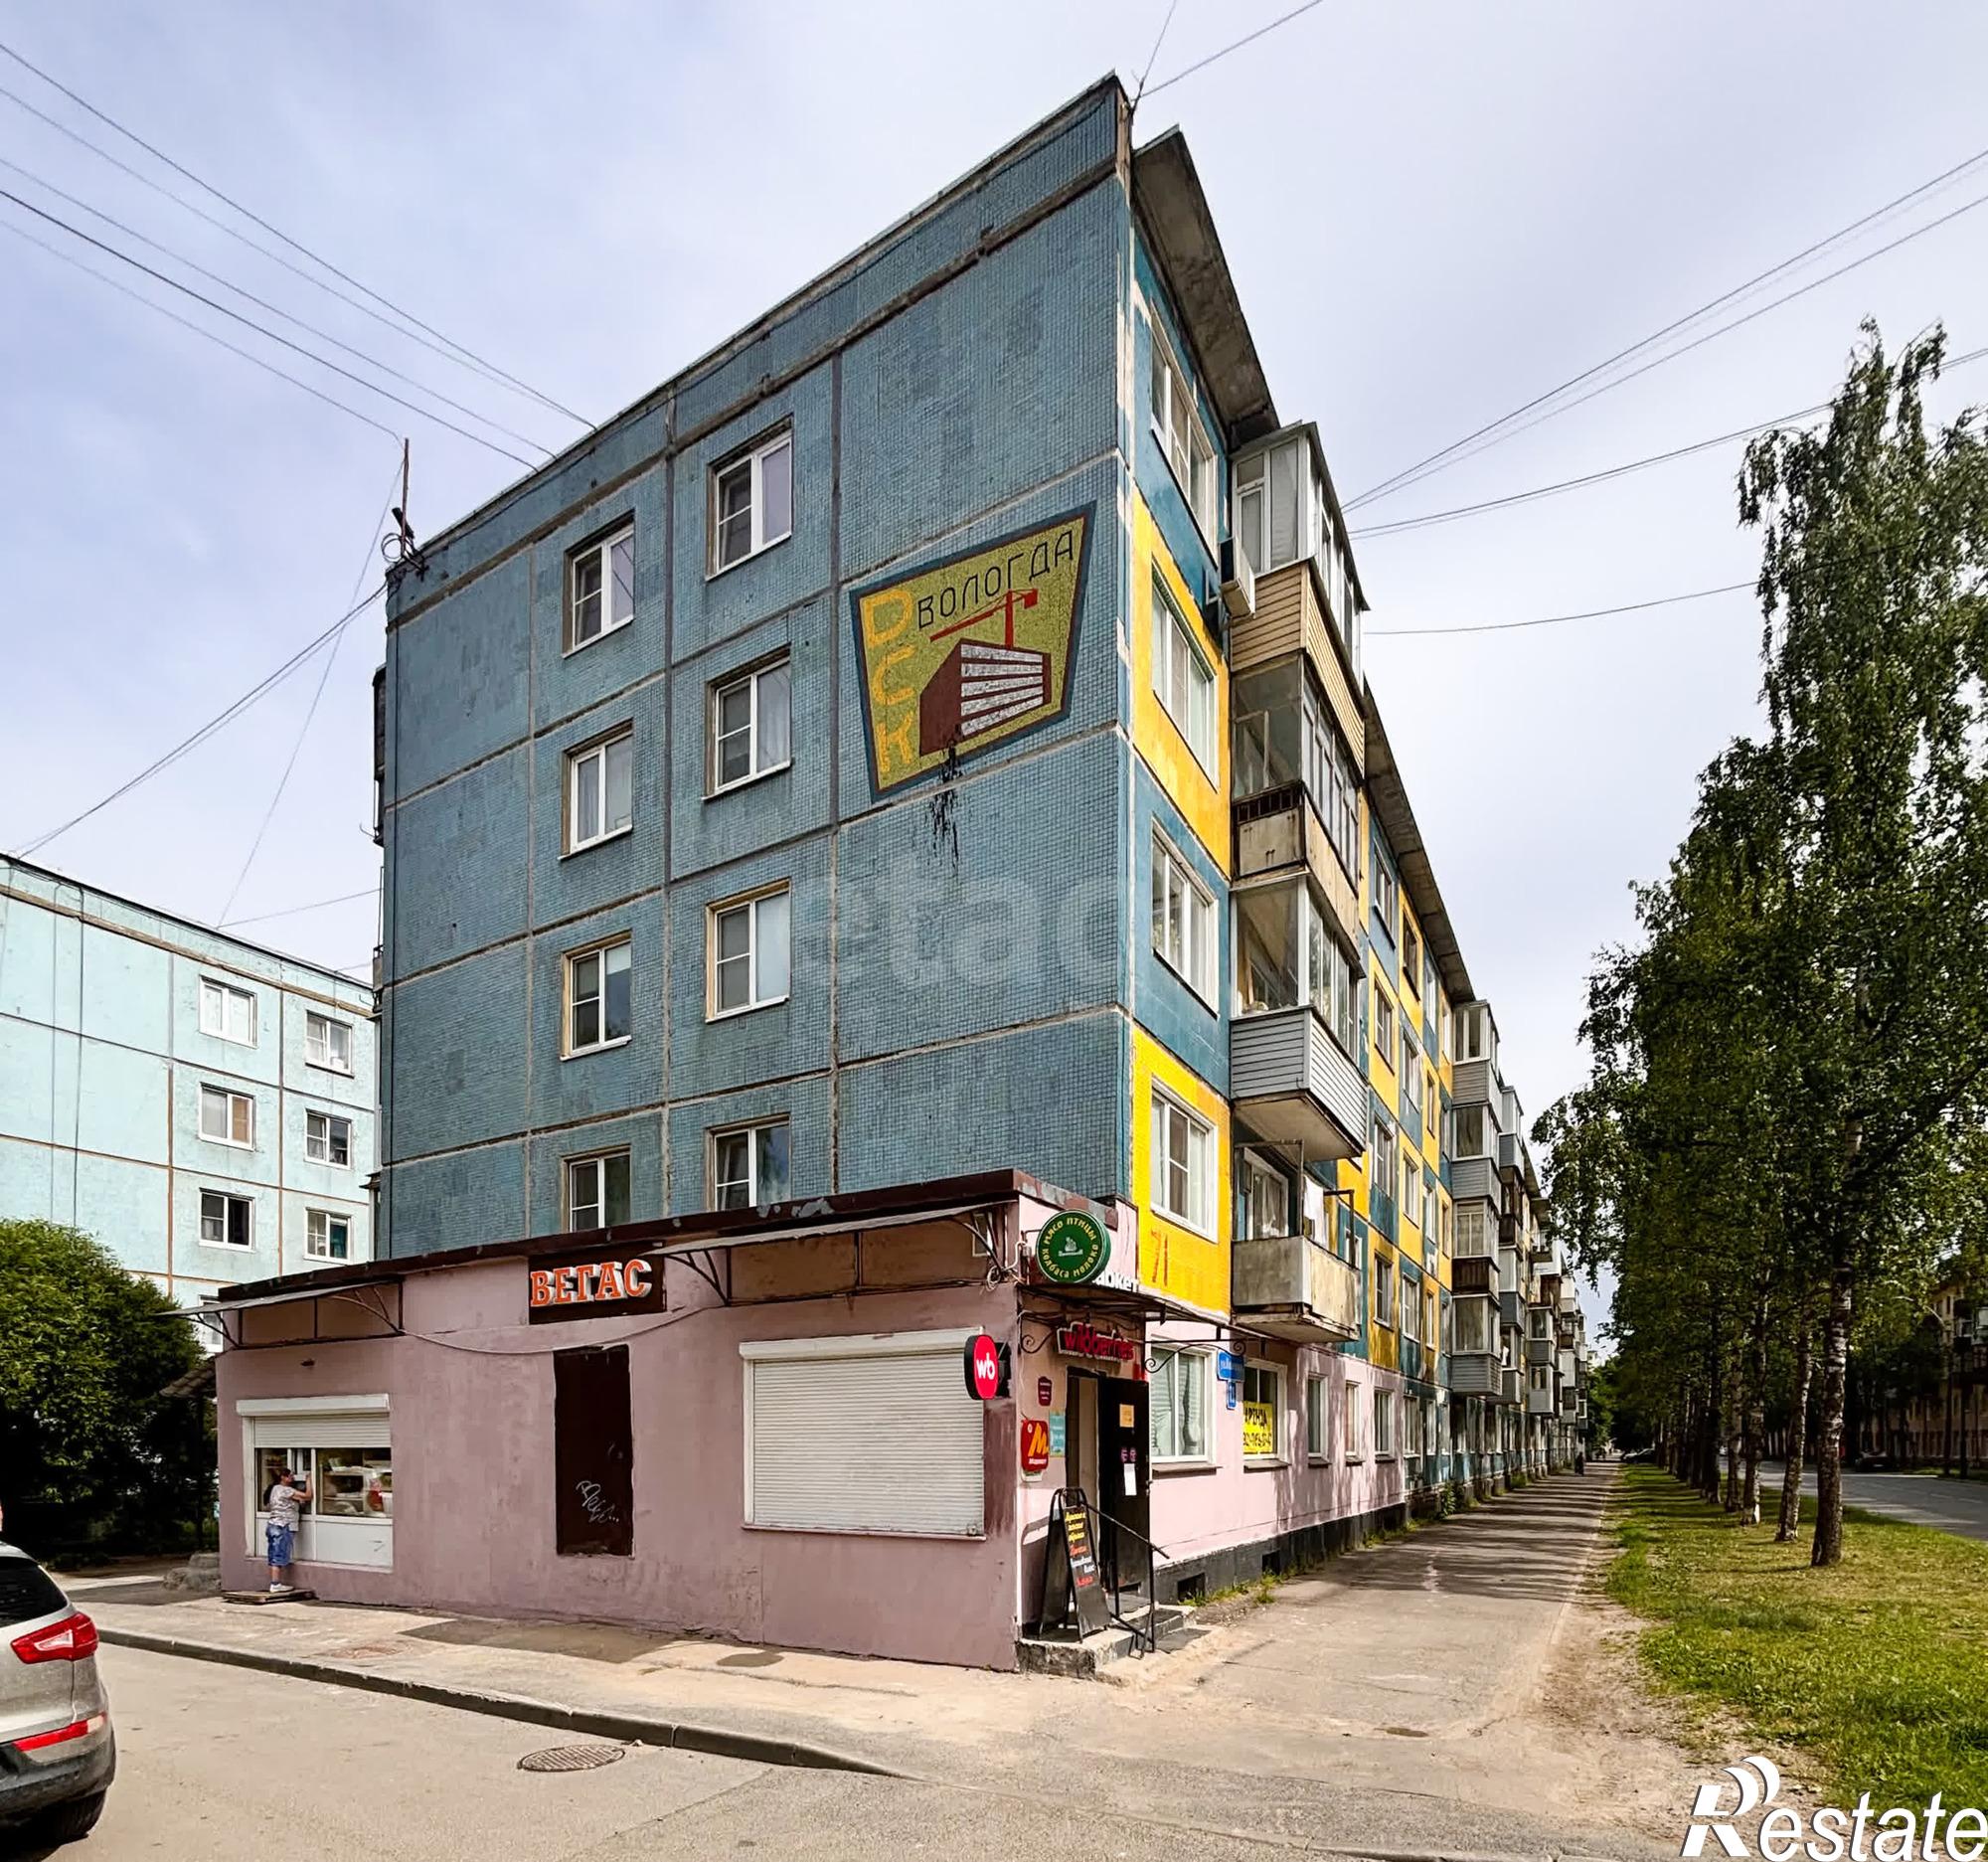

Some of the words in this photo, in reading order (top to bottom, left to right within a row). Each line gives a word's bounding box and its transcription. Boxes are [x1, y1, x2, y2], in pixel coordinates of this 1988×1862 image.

[917, 530, 1074, 629] ВОЛОГДА
[530, 1259, 652, 1307] ВЕГАС
[976, 1352, 996, 1380] wb
